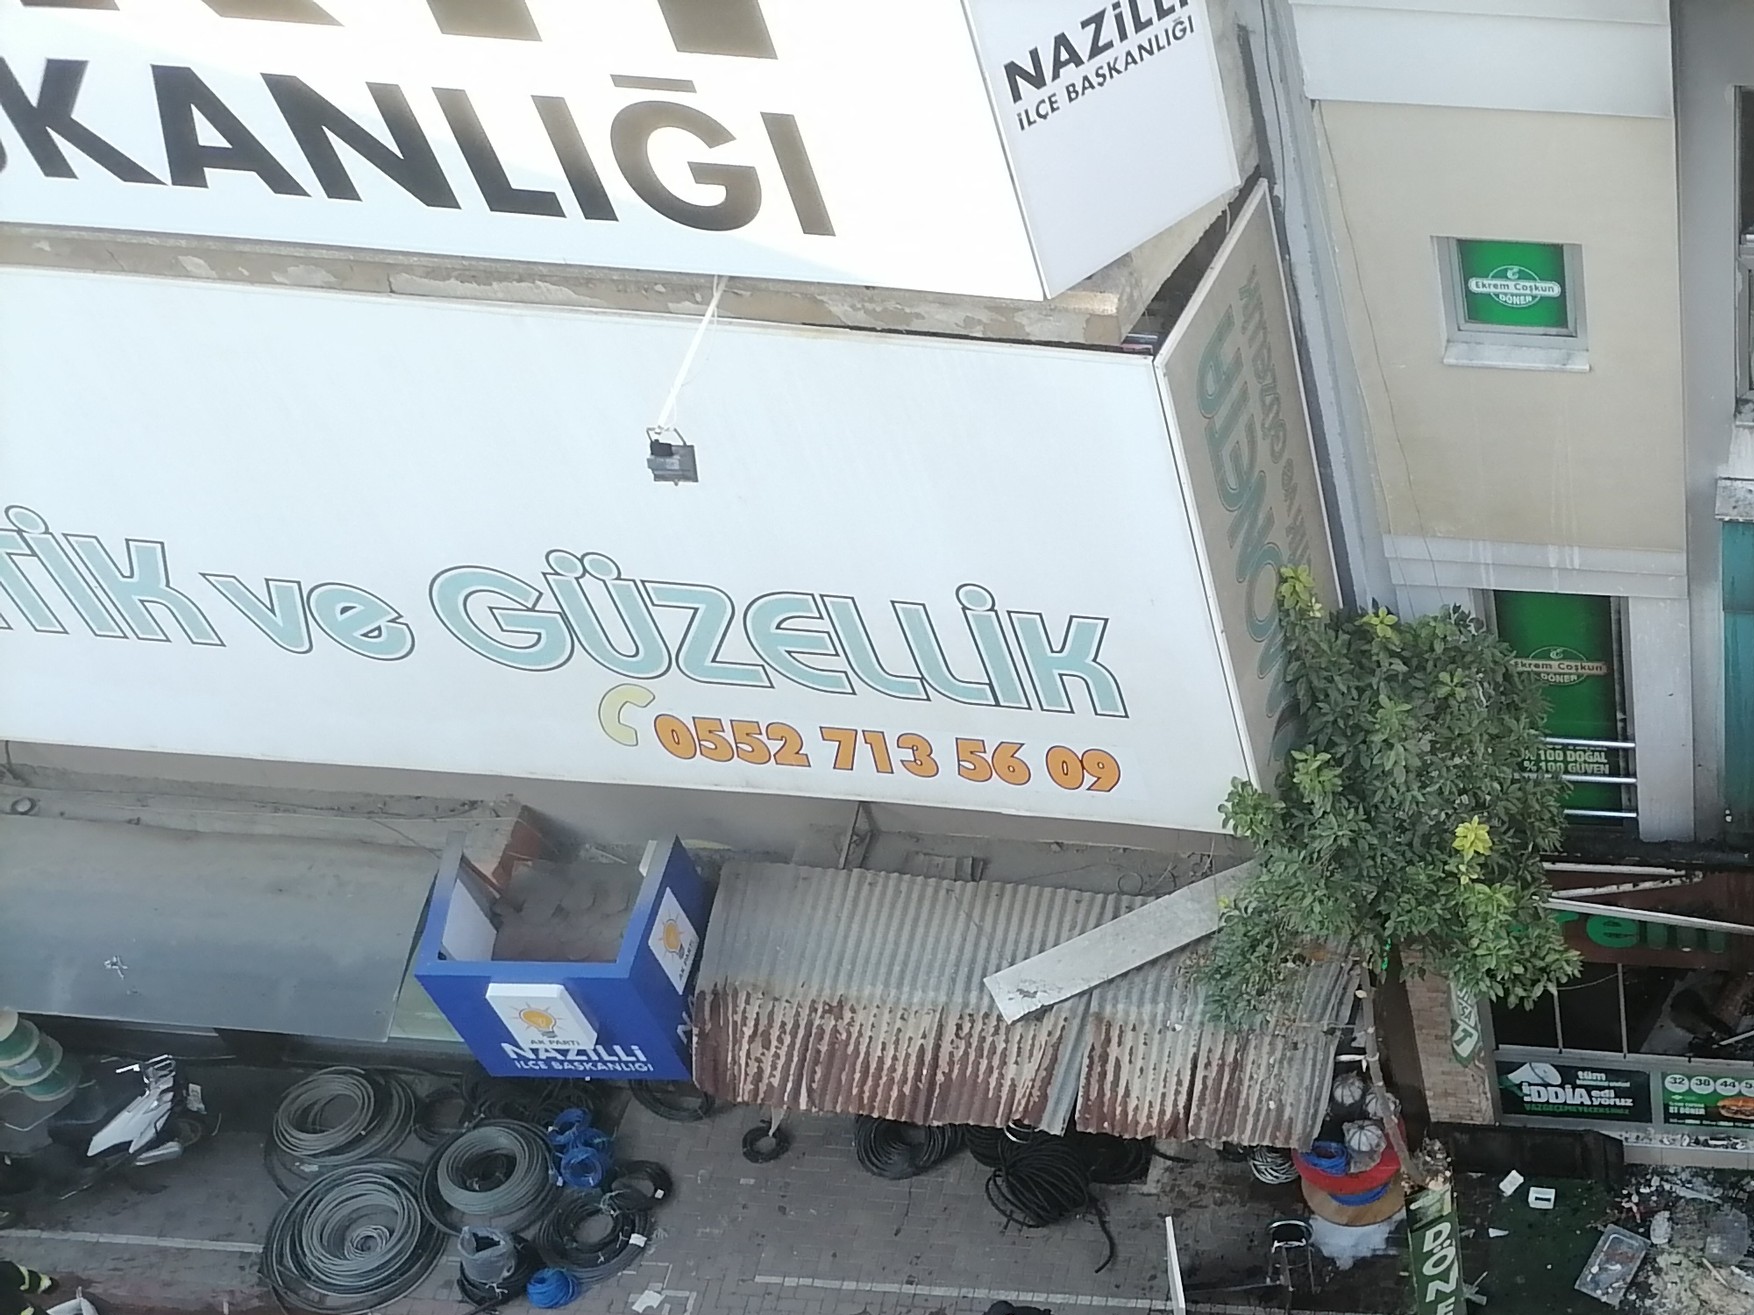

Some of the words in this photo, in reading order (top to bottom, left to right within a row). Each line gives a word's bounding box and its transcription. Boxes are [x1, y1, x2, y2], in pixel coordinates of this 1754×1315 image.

[1016, 92, 1060, 131] İLÇE
[1065, 14, 1194, 103] BAŞKANLIĞI
[0, 57, 836, 237] KANLIĞI
[1475, 280, 1510, 291] Ekrem
[1513, 282, 1555, 294] Coşkun
[1498, 294, 1533, 305] DÖNER
[0, 504, 226, 648] TİK
[200, 572, 415, 661] ve
[428, 549, 1130, 718] GÜZELLİK
[1557, 662, 1603, 673] Coşkun
[653, 712, 811, 768] 0552
[819, 725, 940, 778] 713
[954, 736, 1032, 786] 56
[1044, 744, 1122, 793] 09
[1566, 749, 1608, 763] DOĞAL
[1567, 762, 1610, 775] GÜVEN
[1577, 1070, 1607, 1082] tüm
[1669, 1076, 1686, 1086] 32
[1694, 1077, 1711, 1087] 38
[1719, 1080, 1736, 1089] 44
